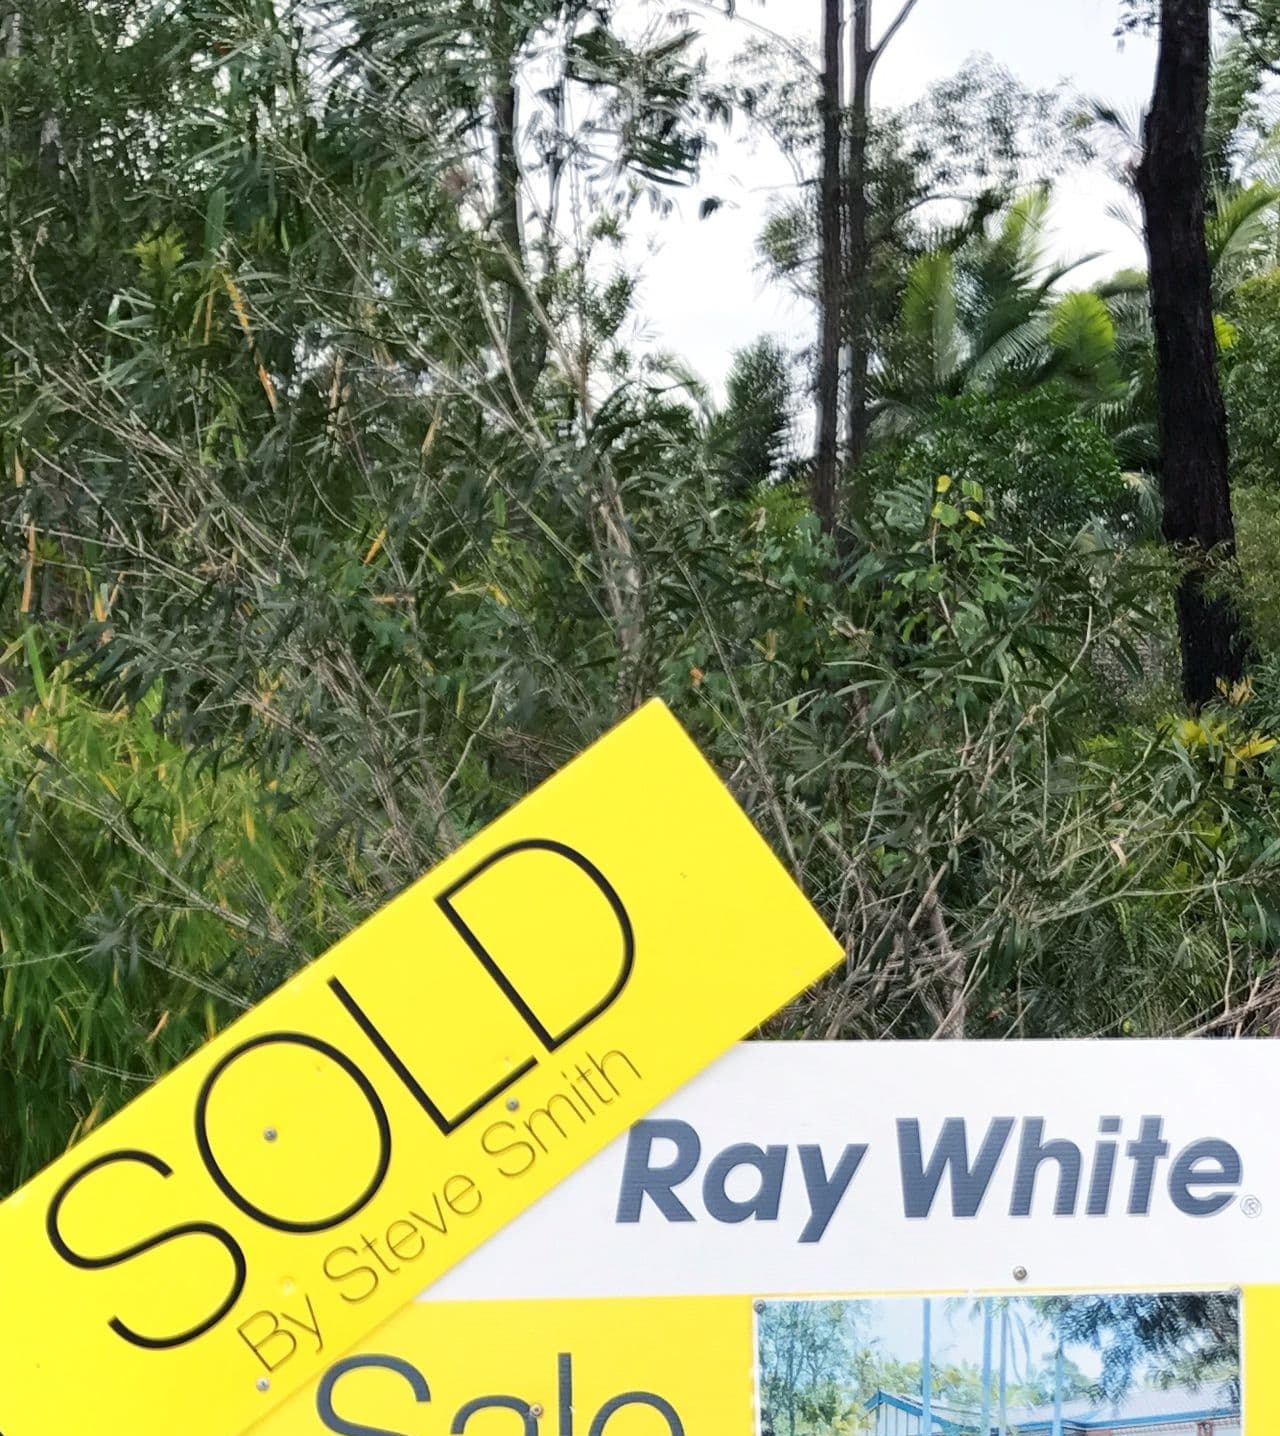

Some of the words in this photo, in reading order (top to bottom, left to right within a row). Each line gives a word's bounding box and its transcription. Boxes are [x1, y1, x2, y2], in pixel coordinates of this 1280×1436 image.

[46, 838, 636, 1350] SOLD
[237, 1292, 324, 1373] By
[322, 1170, 483, 1304] Steve
[483, 1043, 643, 1179] Smith
[615, 1117, 869, 1244] Ray
[896, 1114, 1245, 1220] White
